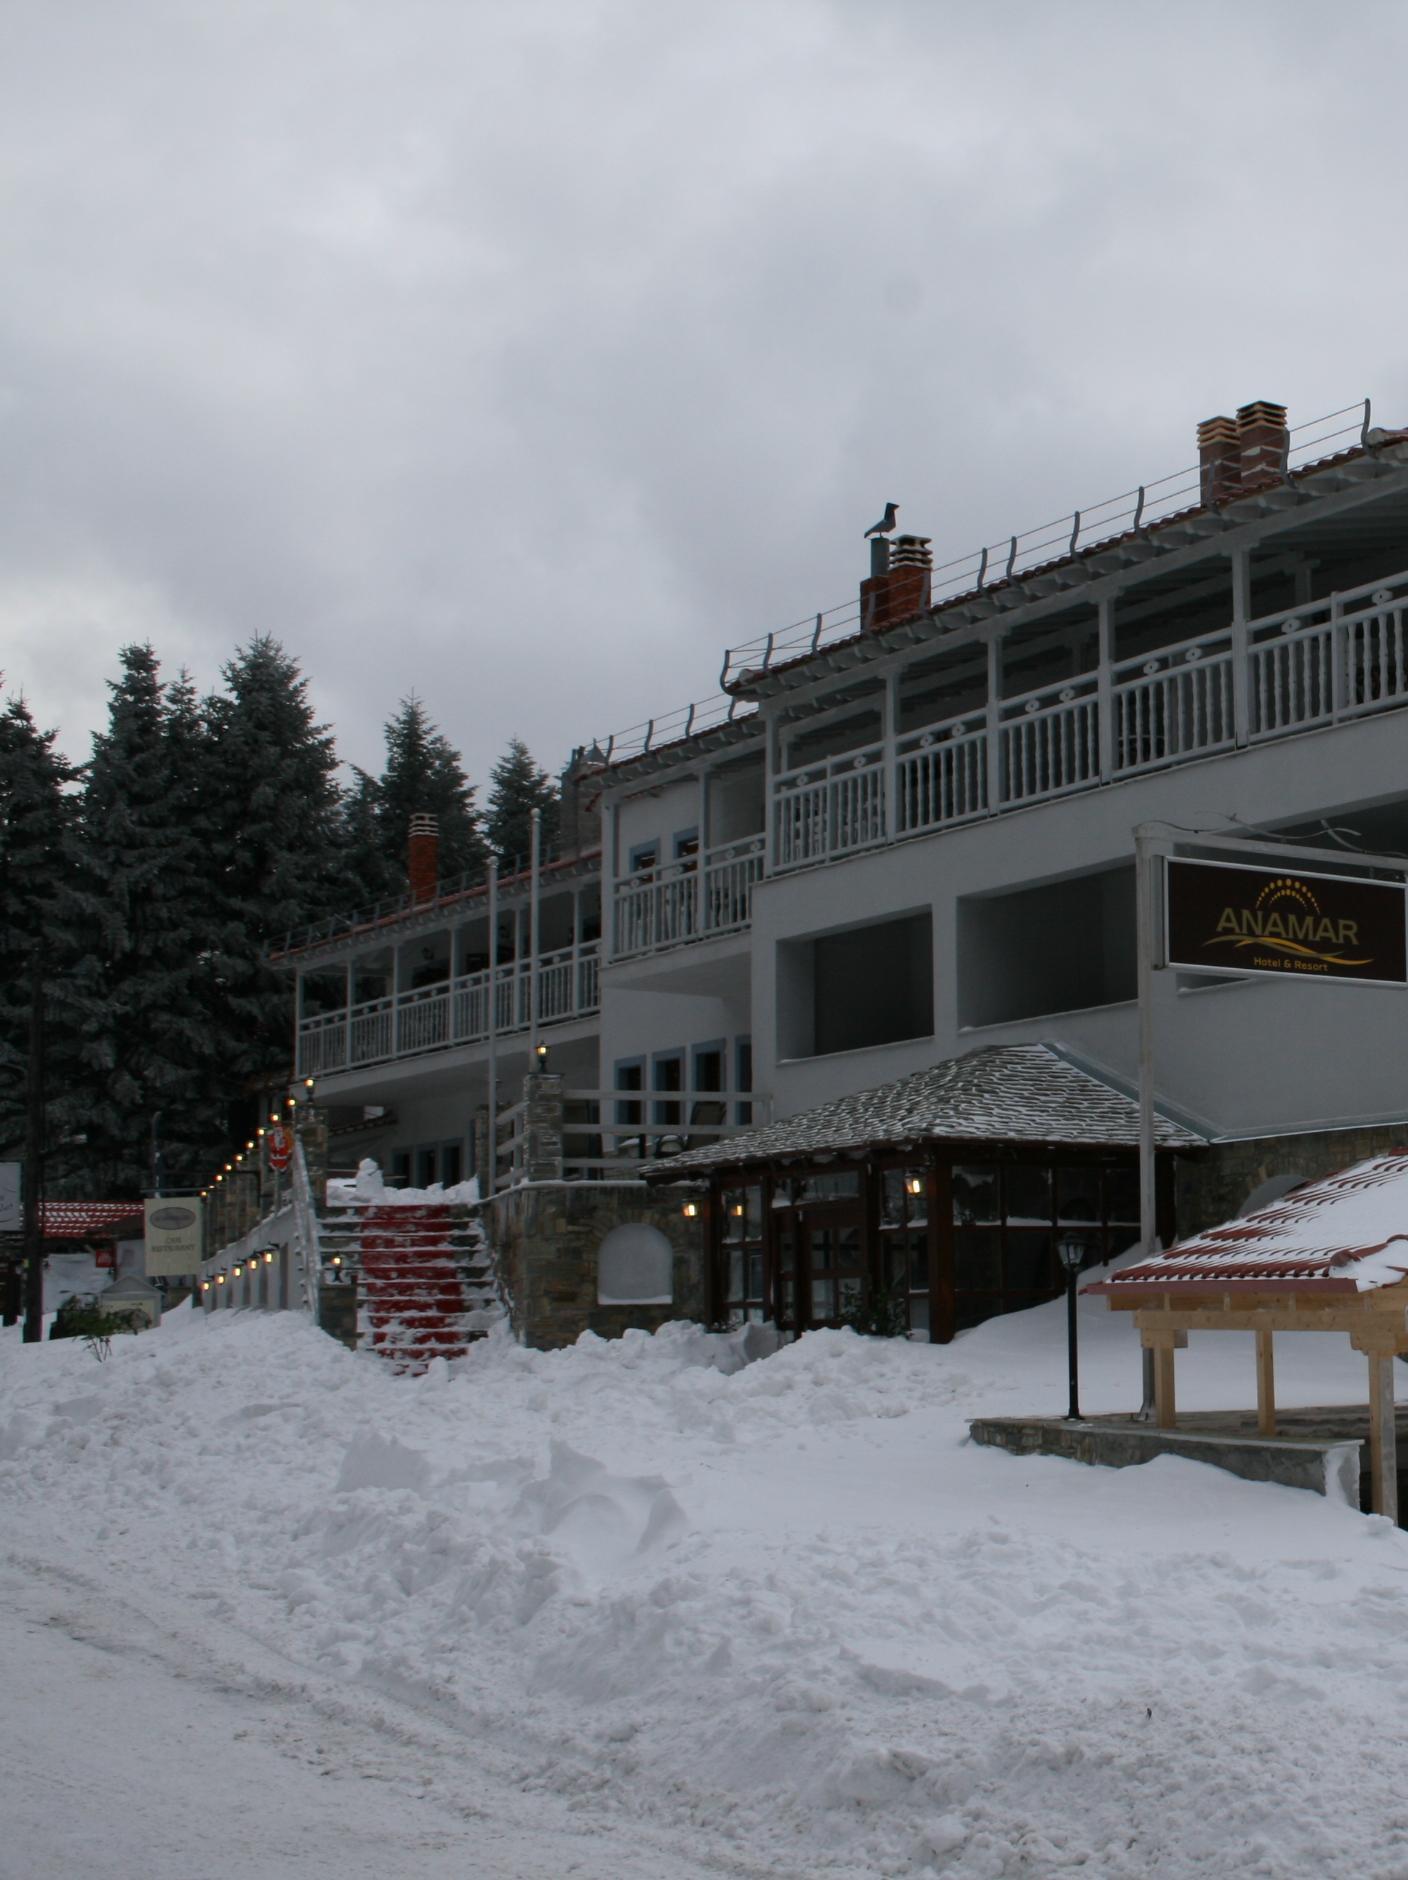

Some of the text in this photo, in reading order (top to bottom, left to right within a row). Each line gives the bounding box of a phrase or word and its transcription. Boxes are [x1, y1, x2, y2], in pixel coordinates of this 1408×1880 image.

[1216, 907, 1360, 946] ANAMAR
[1254, 956, 1328, 972] Hotel & Resort
